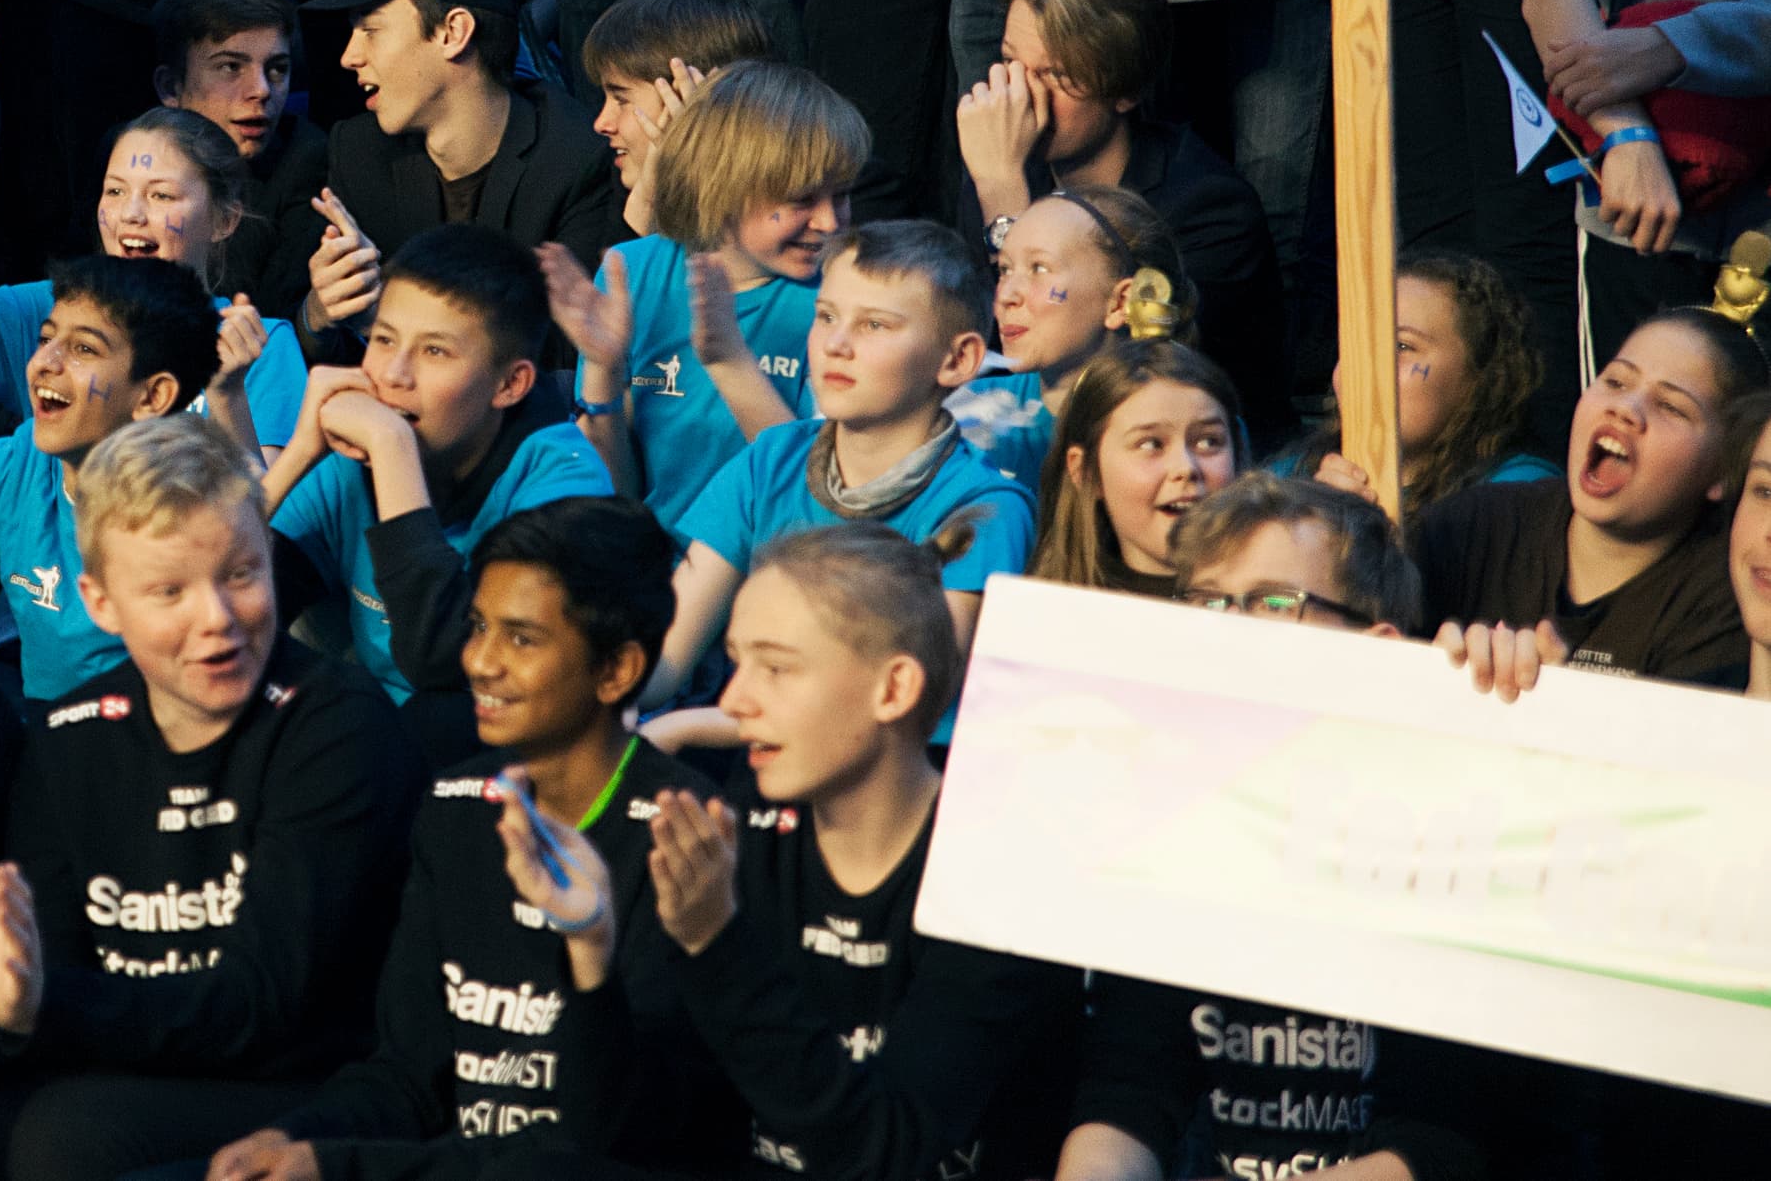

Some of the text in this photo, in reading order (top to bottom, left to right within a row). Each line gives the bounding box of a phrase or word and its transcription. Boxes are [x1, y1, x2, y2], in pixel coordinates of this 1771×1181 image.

[130, 153, 152, 169] 19
[47, 701, 100, 728] SPORT
[169, 786, 210, 805] TEAM
